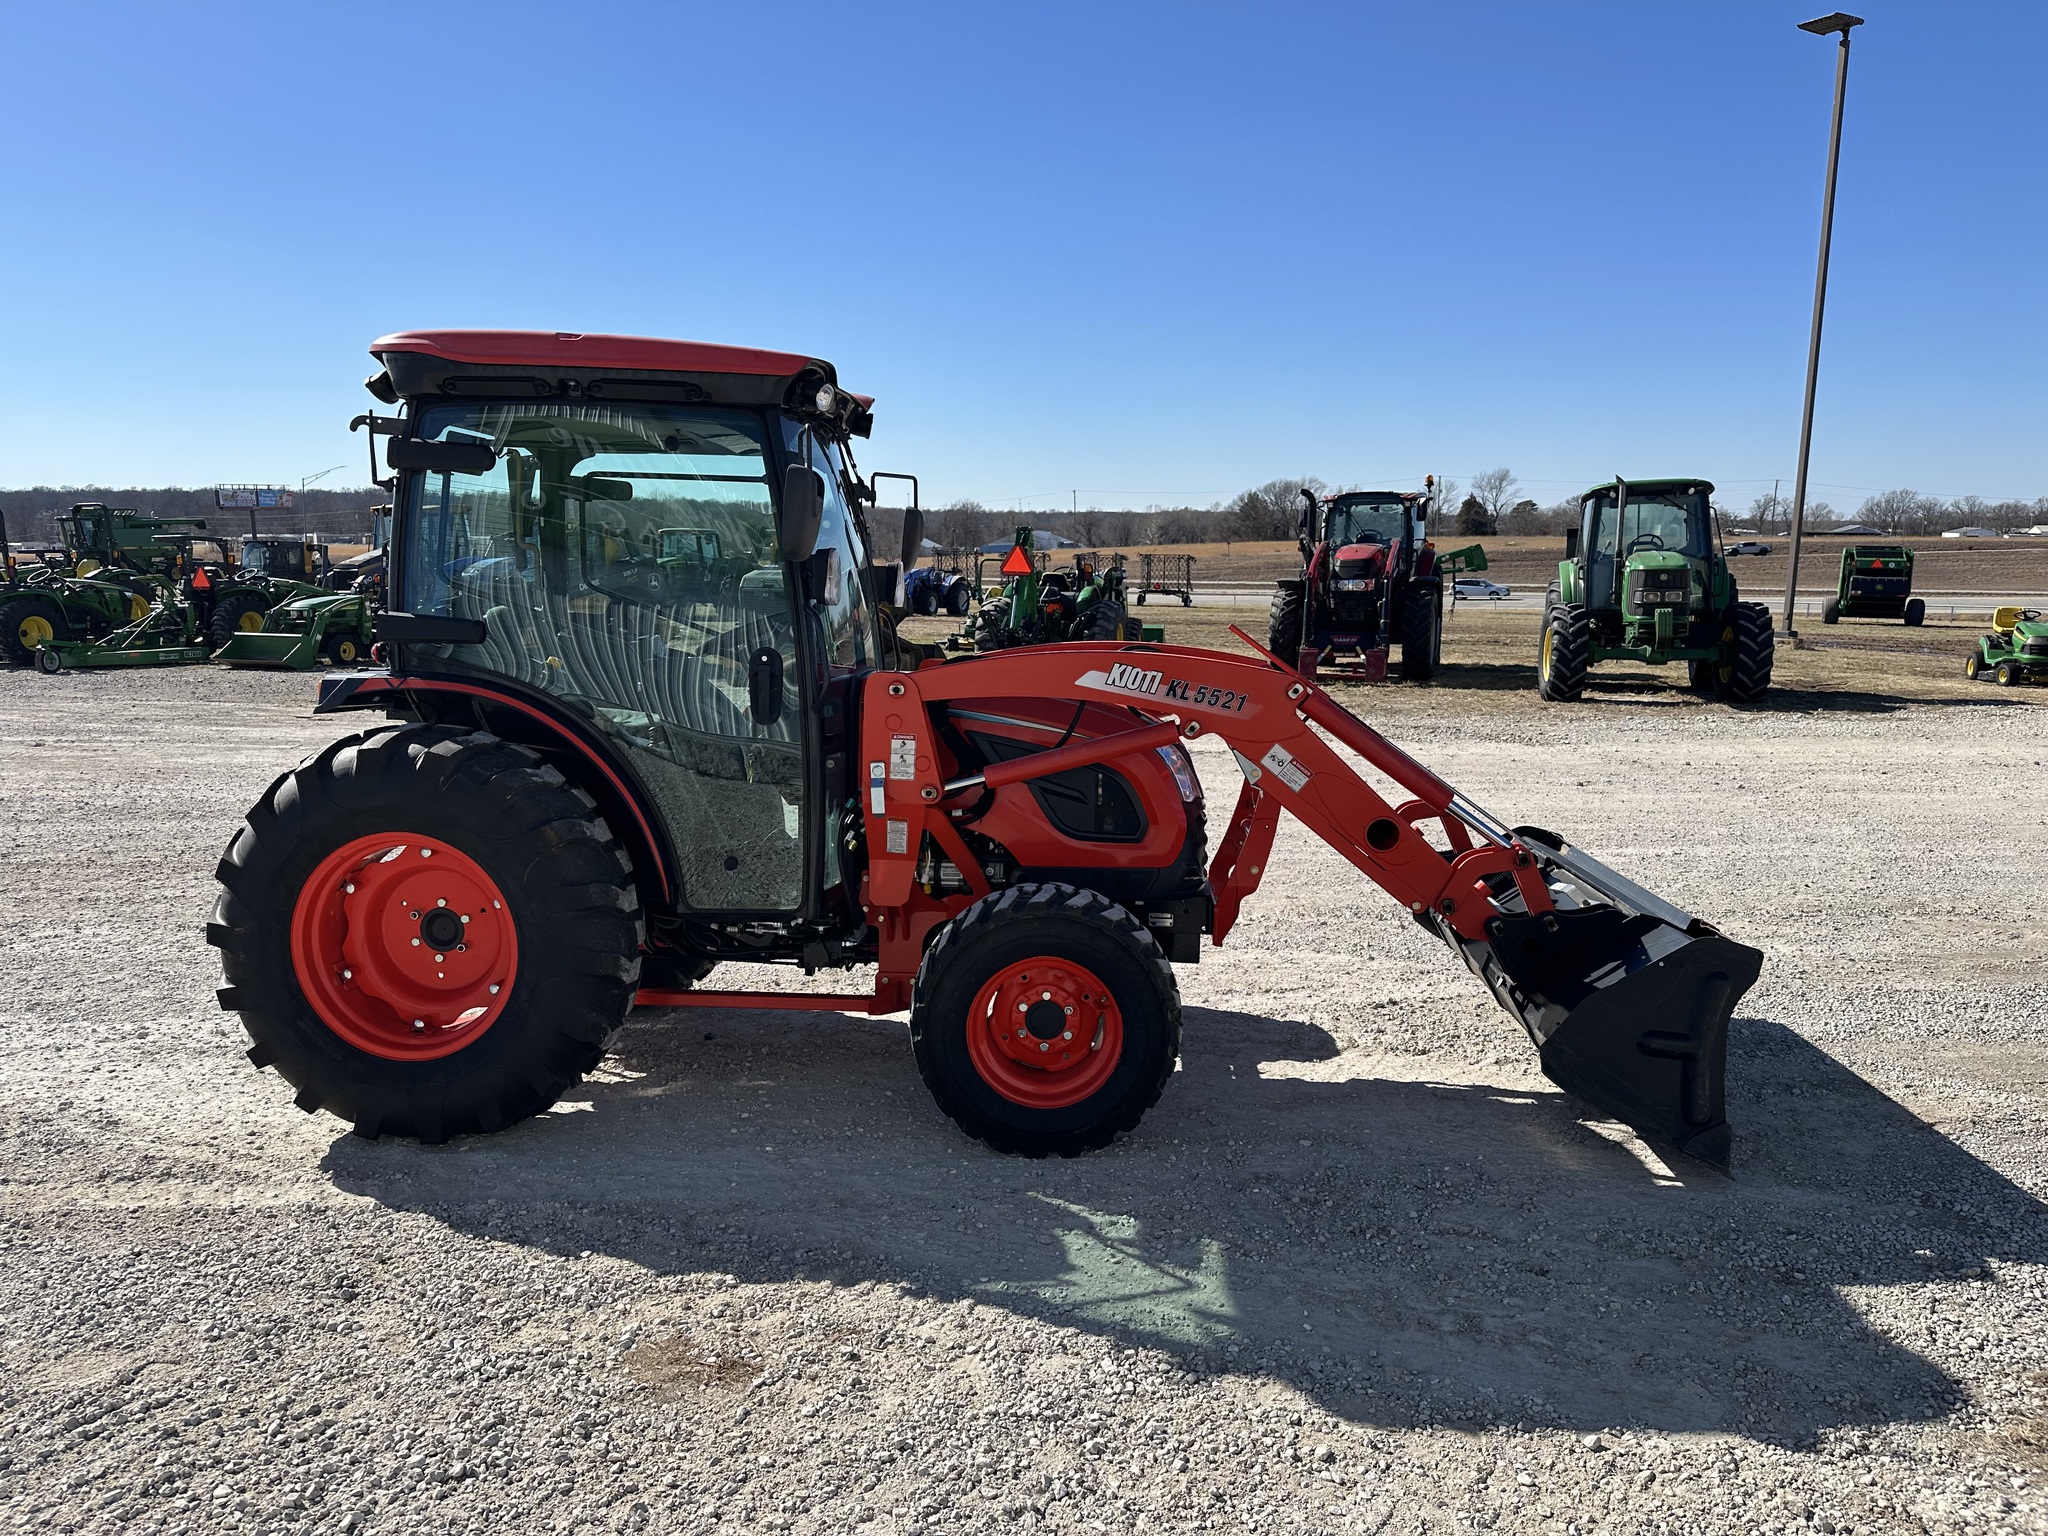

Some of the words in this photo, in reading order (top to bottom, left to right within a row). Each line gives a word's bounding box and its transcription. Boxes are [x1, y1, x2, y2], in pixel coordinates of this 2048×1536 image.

[578, 578, 600, 591] DERE
[1105, 662, 1163, 694] KIOTI
[1165, 679, 1190, 701] KL
[1194, 686, 1249, 713] 5521
